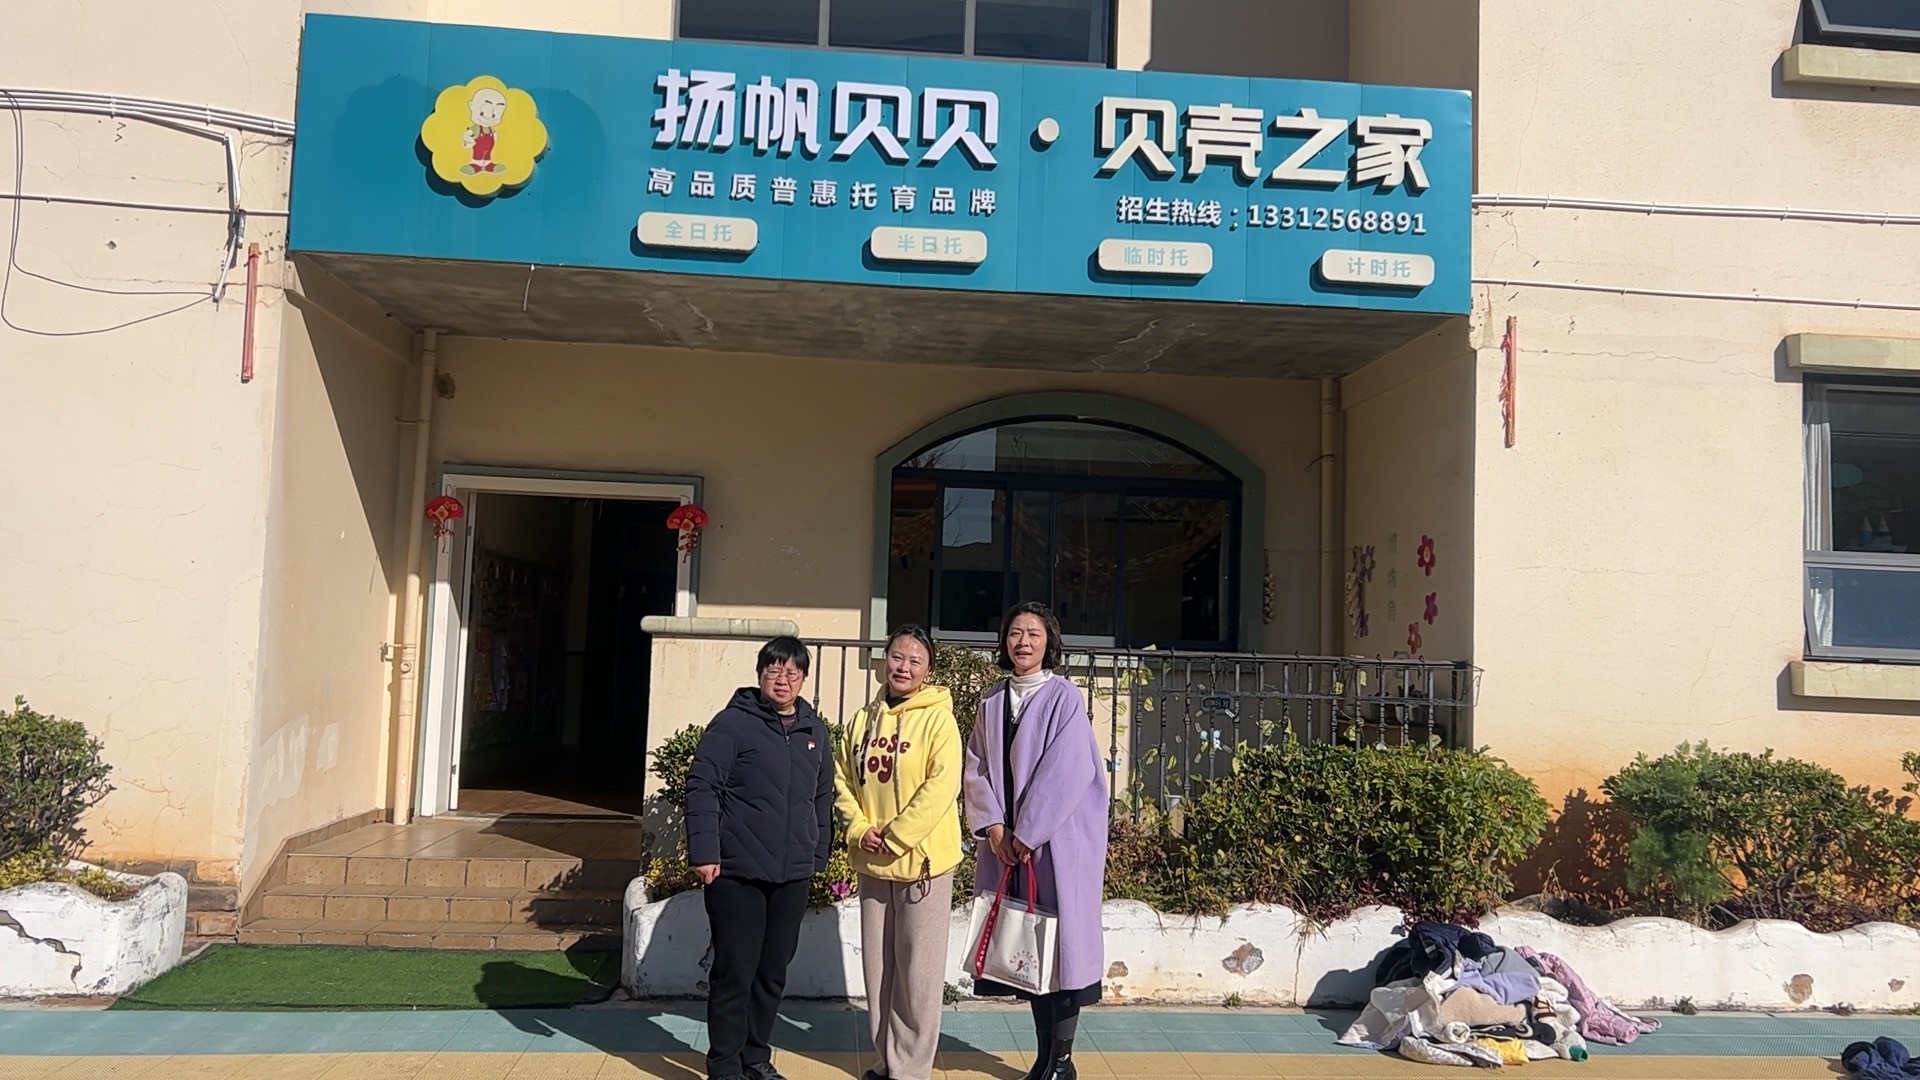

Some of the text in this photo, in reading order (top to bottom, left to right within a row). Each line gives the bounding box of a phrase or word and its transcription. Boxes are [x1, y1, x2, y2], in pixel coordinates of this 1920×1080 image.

[648, 167, 997, 214] 高品质普惠托育品牌
[665, 220, 732, 242] 全日托
[897, 234, 962, 255] 半日托
[1124, 246, 1188, 267] 临时托
[1347, 256, 1411, 279] 计时托
